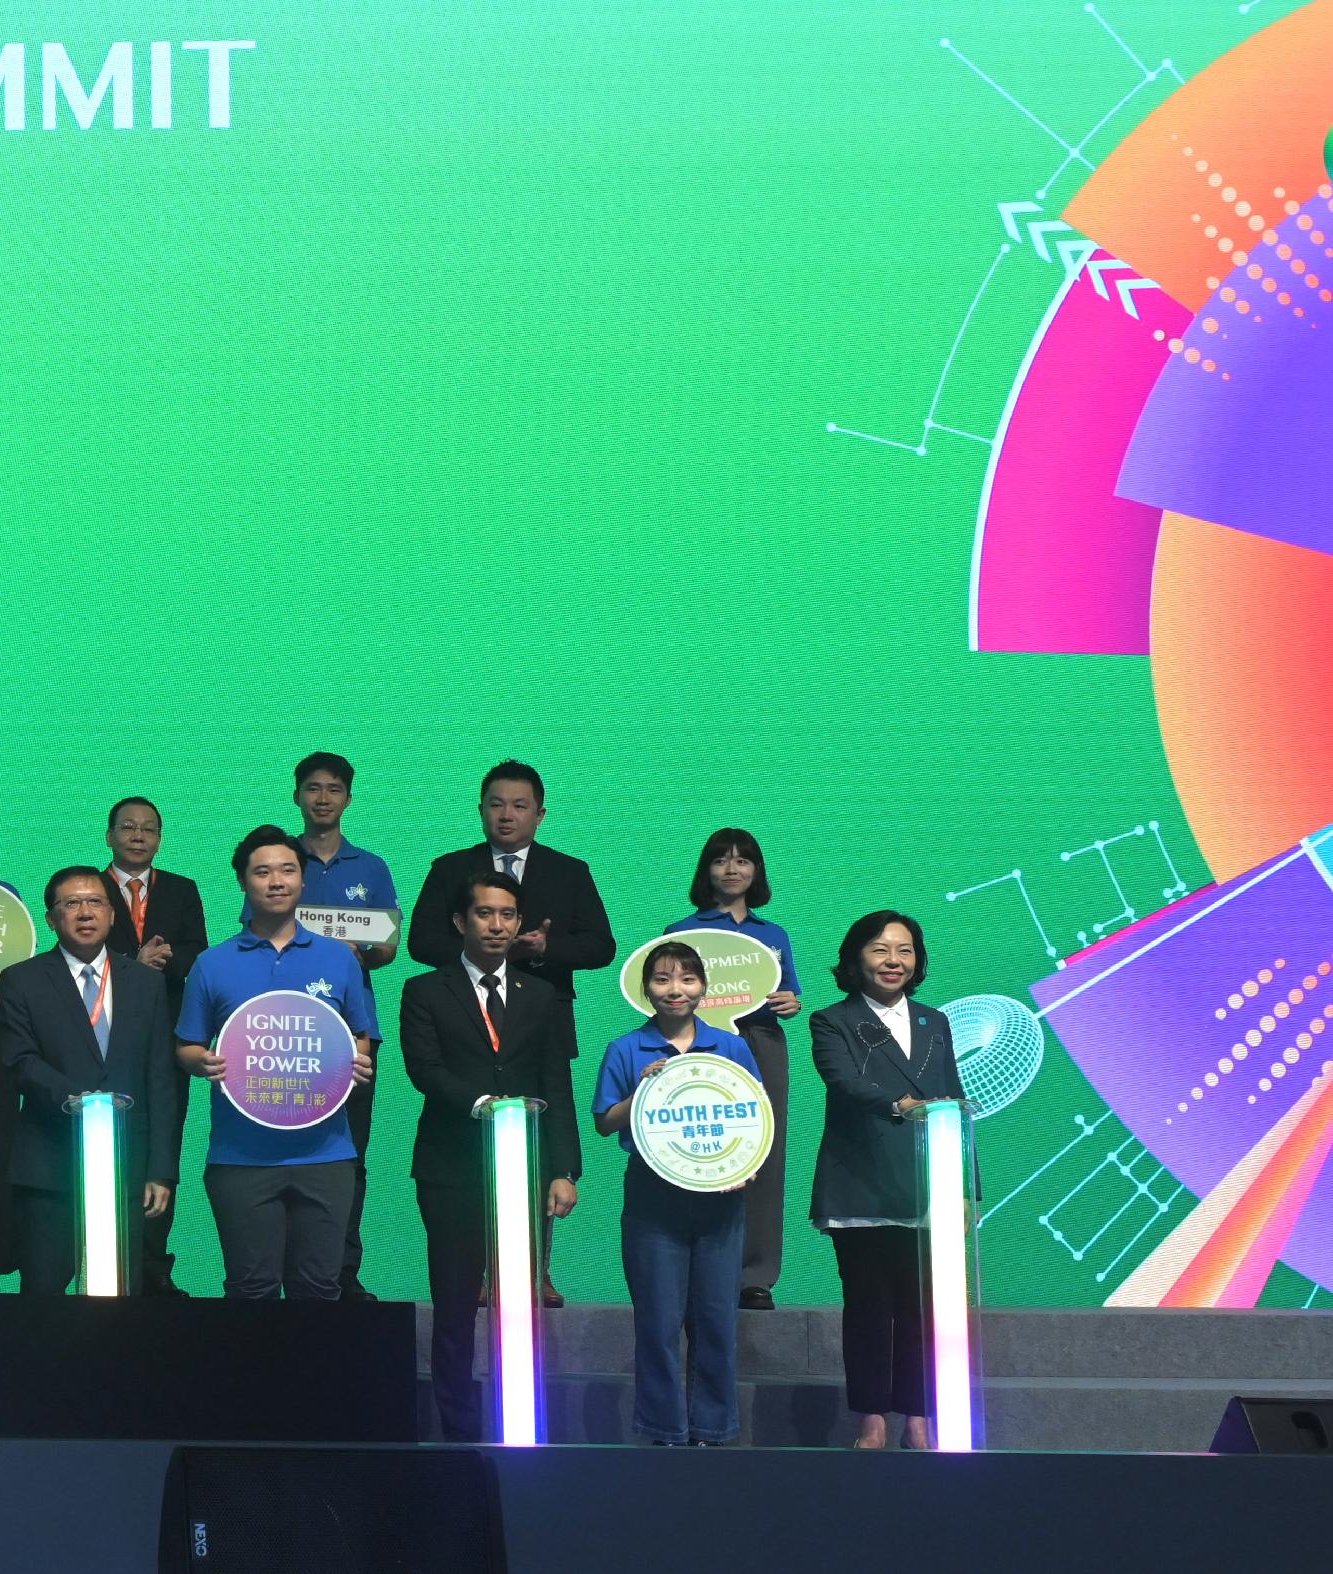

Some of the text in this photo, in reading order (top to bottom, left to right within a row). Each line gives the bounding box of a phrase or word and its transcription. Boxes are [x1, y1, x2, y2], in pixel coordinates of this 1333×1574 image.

[299, 910, 371, 926] Hong Kong
[323, 925, 347, 938] 香港
[246, 1013, 317, 1032] IGNITE
[245, 1034, 322, 1053] YOUTH
[245, 1055, 322, 1074] POWER
[245, 1075, 311, 1091] 正向新世代
[644, 1101, 758, 1125] YOUTH FEST
[681, 1123, 725, 1139] 青年節
[194, 1523, 207, 1557] NEXO
